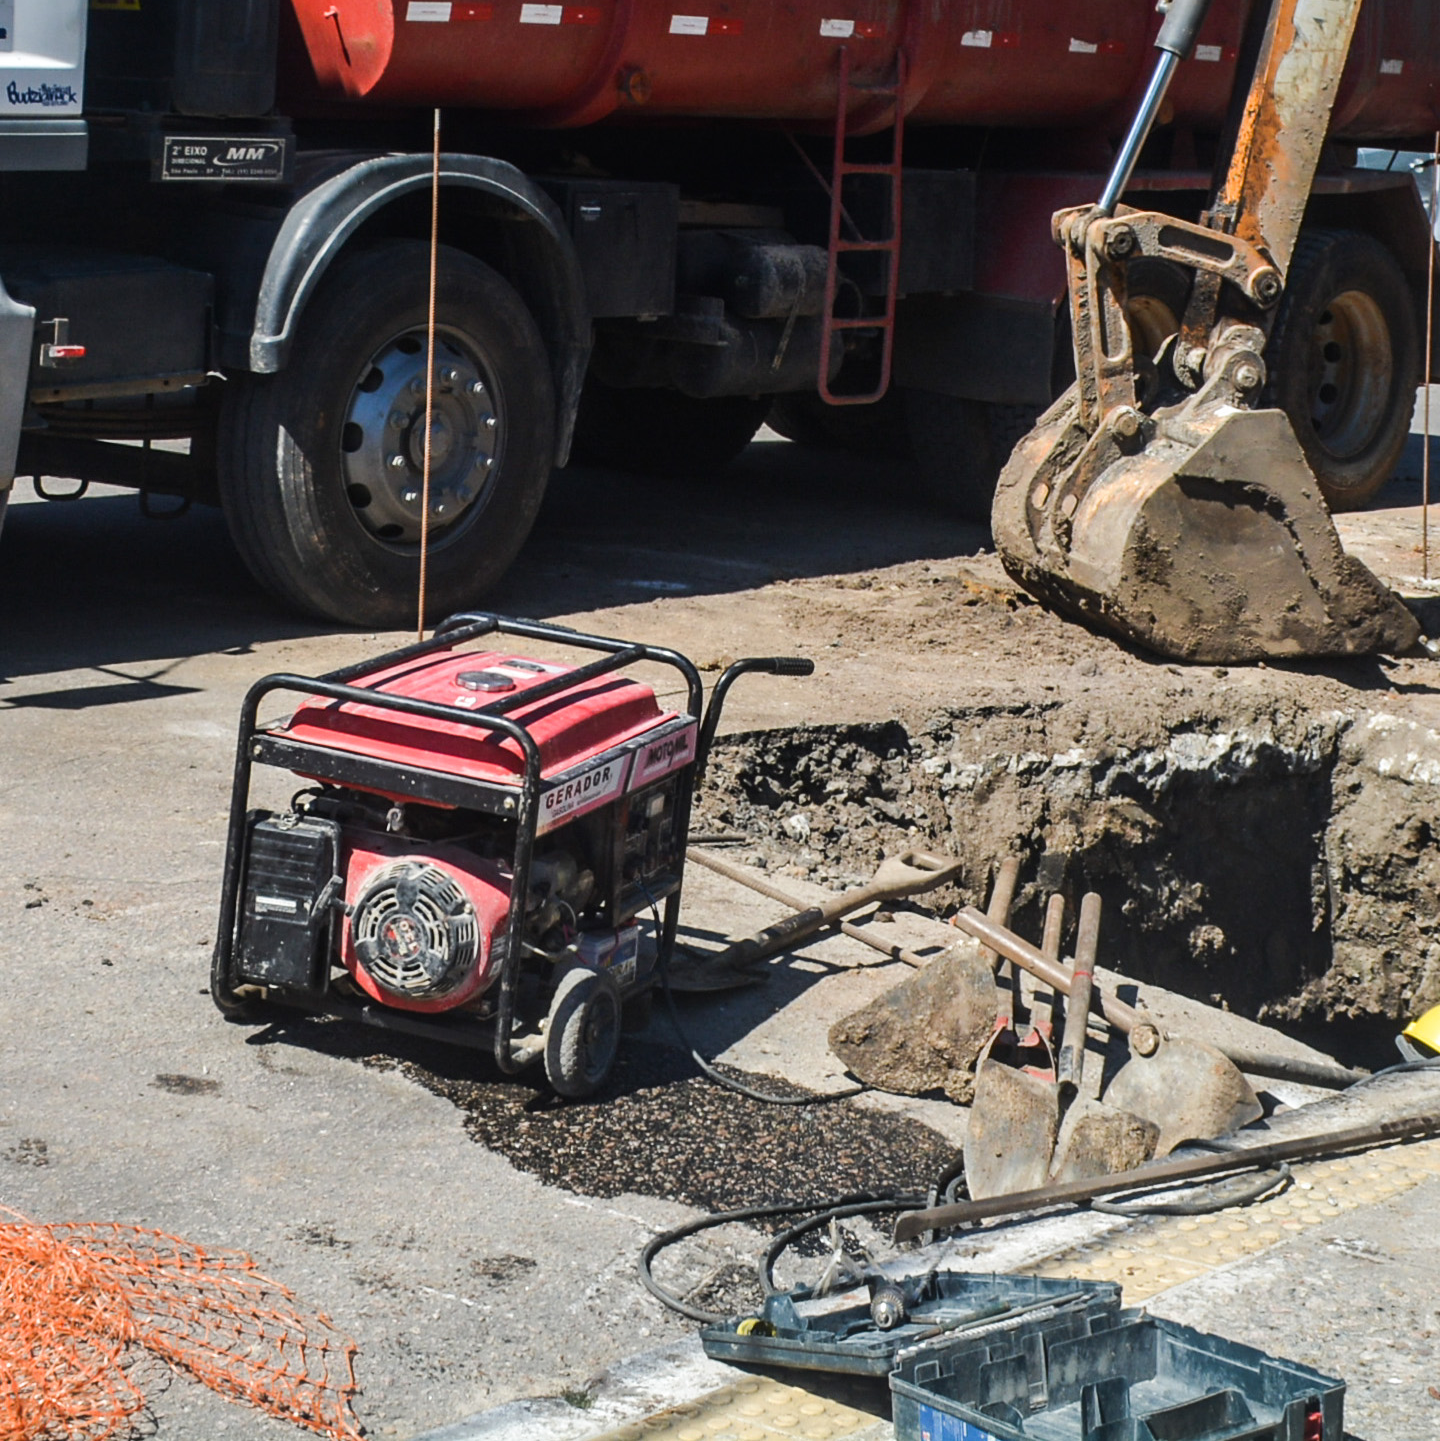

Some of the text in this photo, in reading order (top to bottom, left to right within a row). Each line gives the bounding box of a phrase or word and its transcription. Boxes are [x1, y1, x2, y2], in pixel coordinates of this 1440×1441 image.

[184, 146, 208, 156] EIXO
[226, 147, 266, 161] MM
[545, 766, 611, 809] GERADOR
